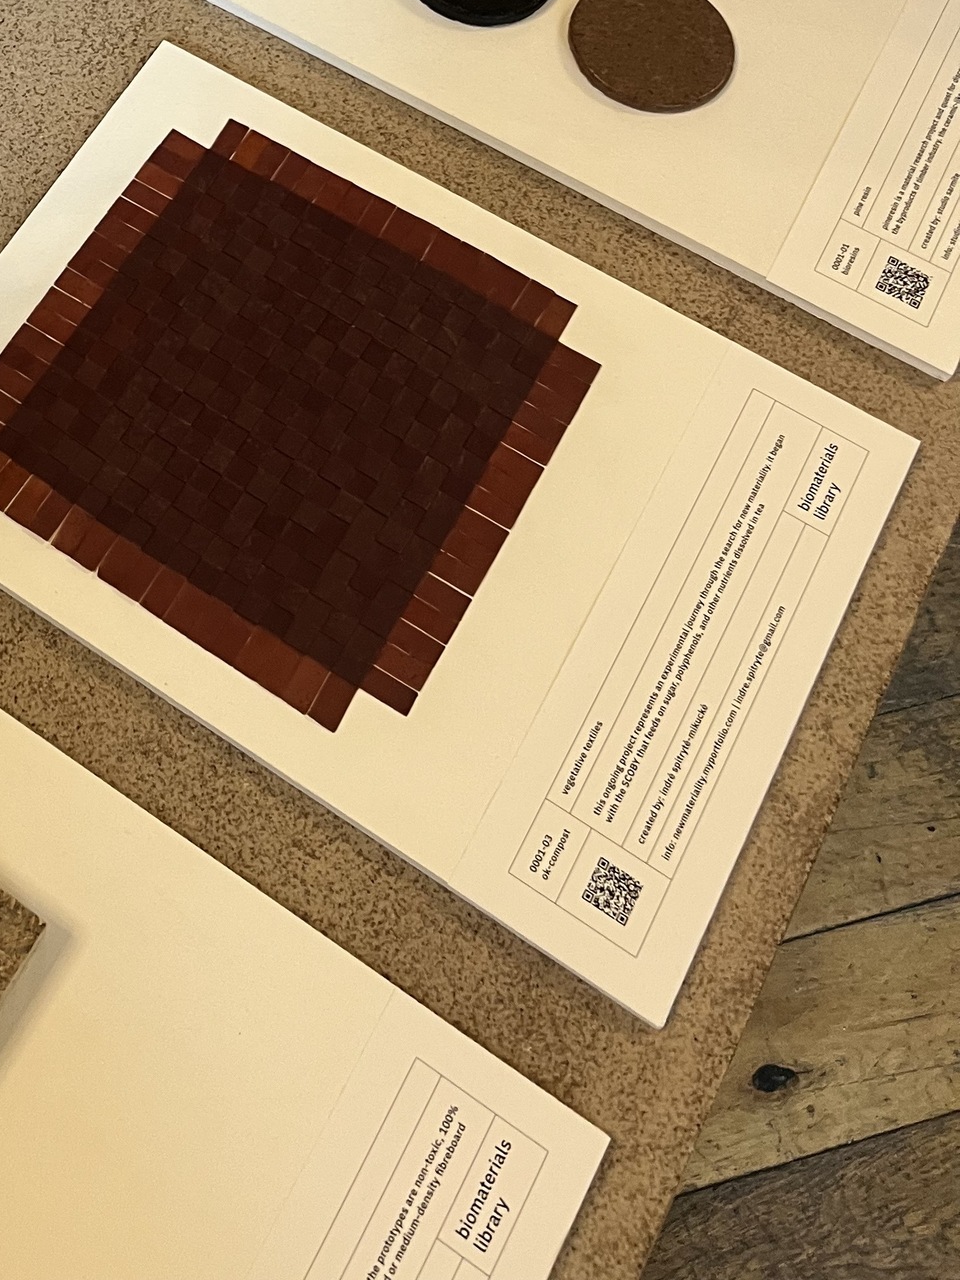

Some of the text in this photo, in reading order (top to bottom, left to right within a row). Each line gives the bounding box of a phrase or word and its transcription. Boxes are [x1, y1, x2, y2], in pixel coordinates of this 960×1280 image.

[853, 186, 872, 217] pine resin
[765, 455, 775, 463] it
[769, 434, 785, 456] began
[797, 443, 839, 512] biomaterials
[739, 503, 751, 520] new
[813, 482, 841, 520] library
[721, 531, 738, 556] search
[732, 519, 743, 531] for
[714, 556, 725, 570] the
[699, 569, 719, 600] through
[684, 599, 705, 631] journey
[605, 503, 765, 823] with the SCOBY that feeds on sugar, polyphenols, and other nutrients dissolved in tea
[661, 627, 690, 680] experimental
[654, 679, 665, 692] an
[634, 692, 659, 736] represents
[562, 721, 603, 795] vegetative textiles
[619, 735, 637, 766] project
[603, 764, 625, 799] ongoing
[661, 840, 677, 861] info:
[673, 709, 737, 840] newmateriality.myportfolio.com
[593, 799, 606, 816] this
[638, 809, 658, 845] created
[652, 796, 665, 811] by:
[529, 834, 553, 873] 0001-03
[542, 829, 571, 881] ok-compost
[377, 1207, 409, 1266] prototypes
[405, 1188, 418, 1207] are
[414, 1138, 445, 1188] non-toxic,
[439, 1105, 459, 1136] 100%
[387, 1121, 466, 1275] or medium-density fibreboard
[455, 1139, 512, 1240] biomaterials
[473, 1197, 510, 1253] library
